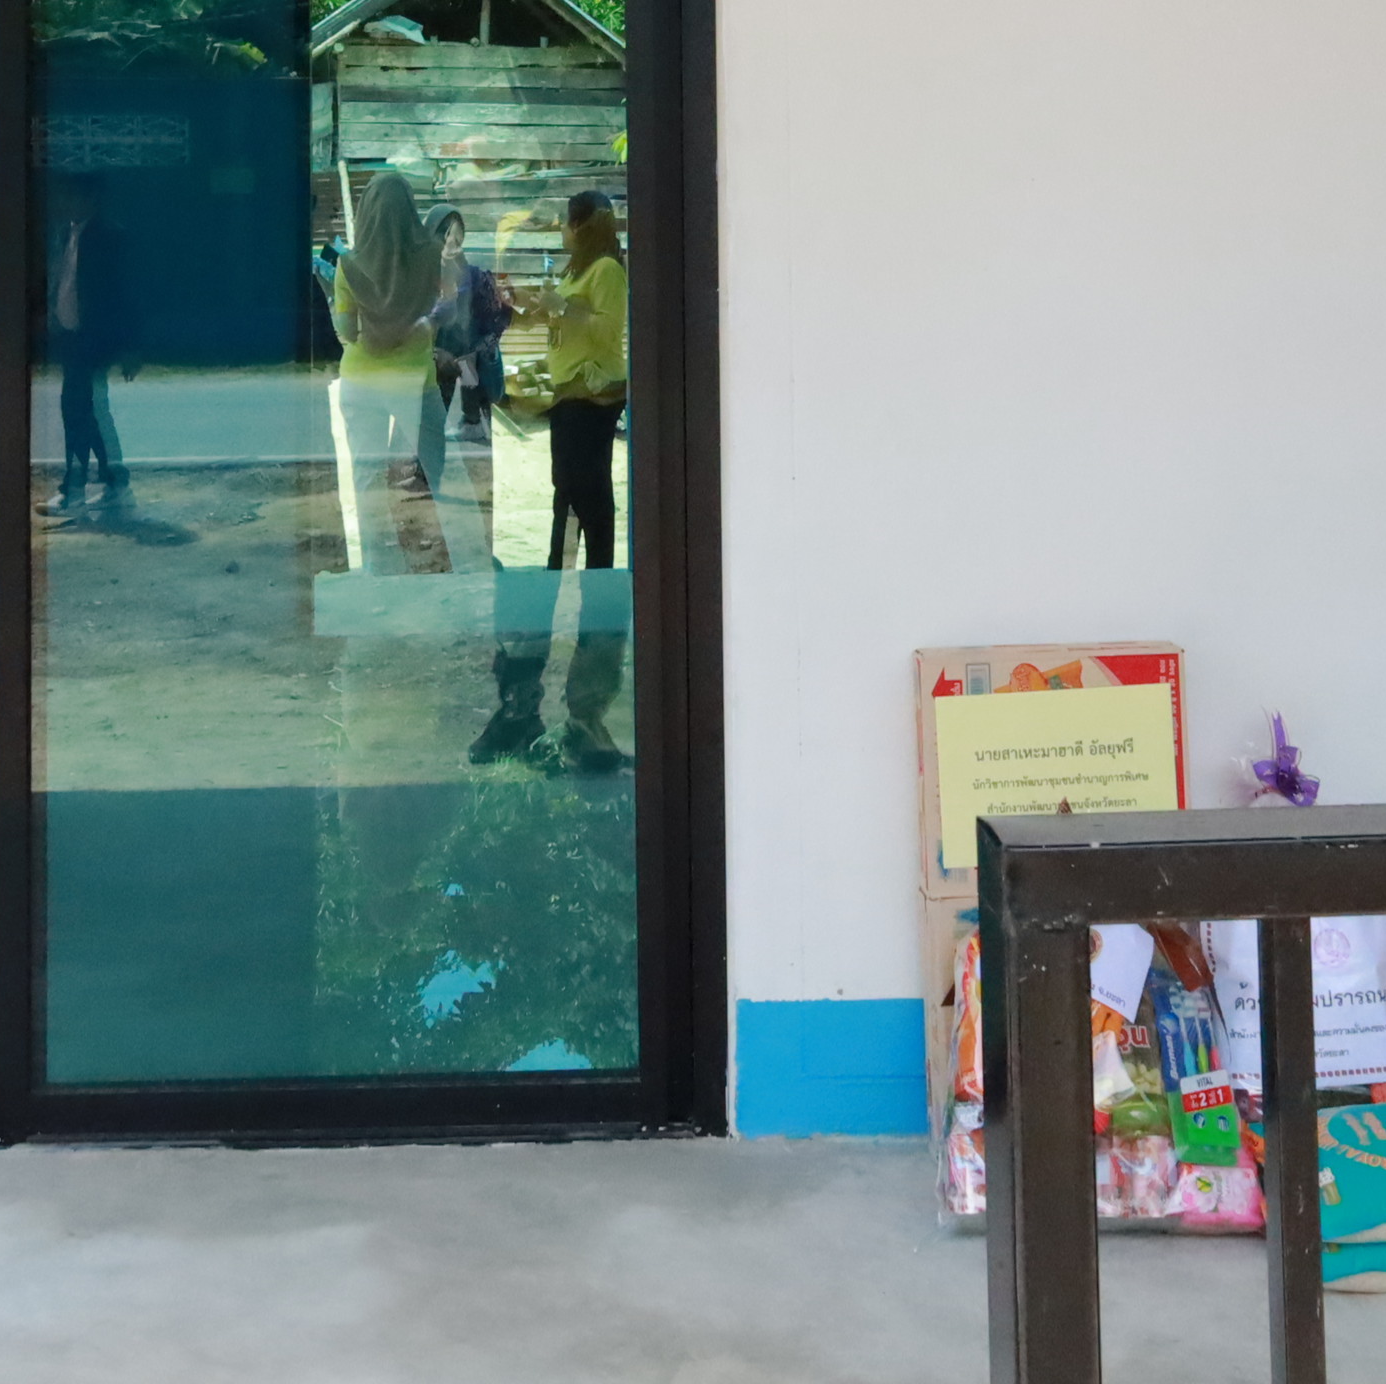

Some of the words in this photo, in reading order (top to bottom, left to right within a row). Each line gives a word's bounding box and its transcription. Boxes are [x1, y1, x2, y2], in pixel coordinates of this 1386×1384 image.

[987, 796, 1138, 814] สำนักงานพัฒนาชนจังหวัดยะลา
[1199, 1092, 1208, 1107] 2
[1217, 1088, 1224, 1103] 1
